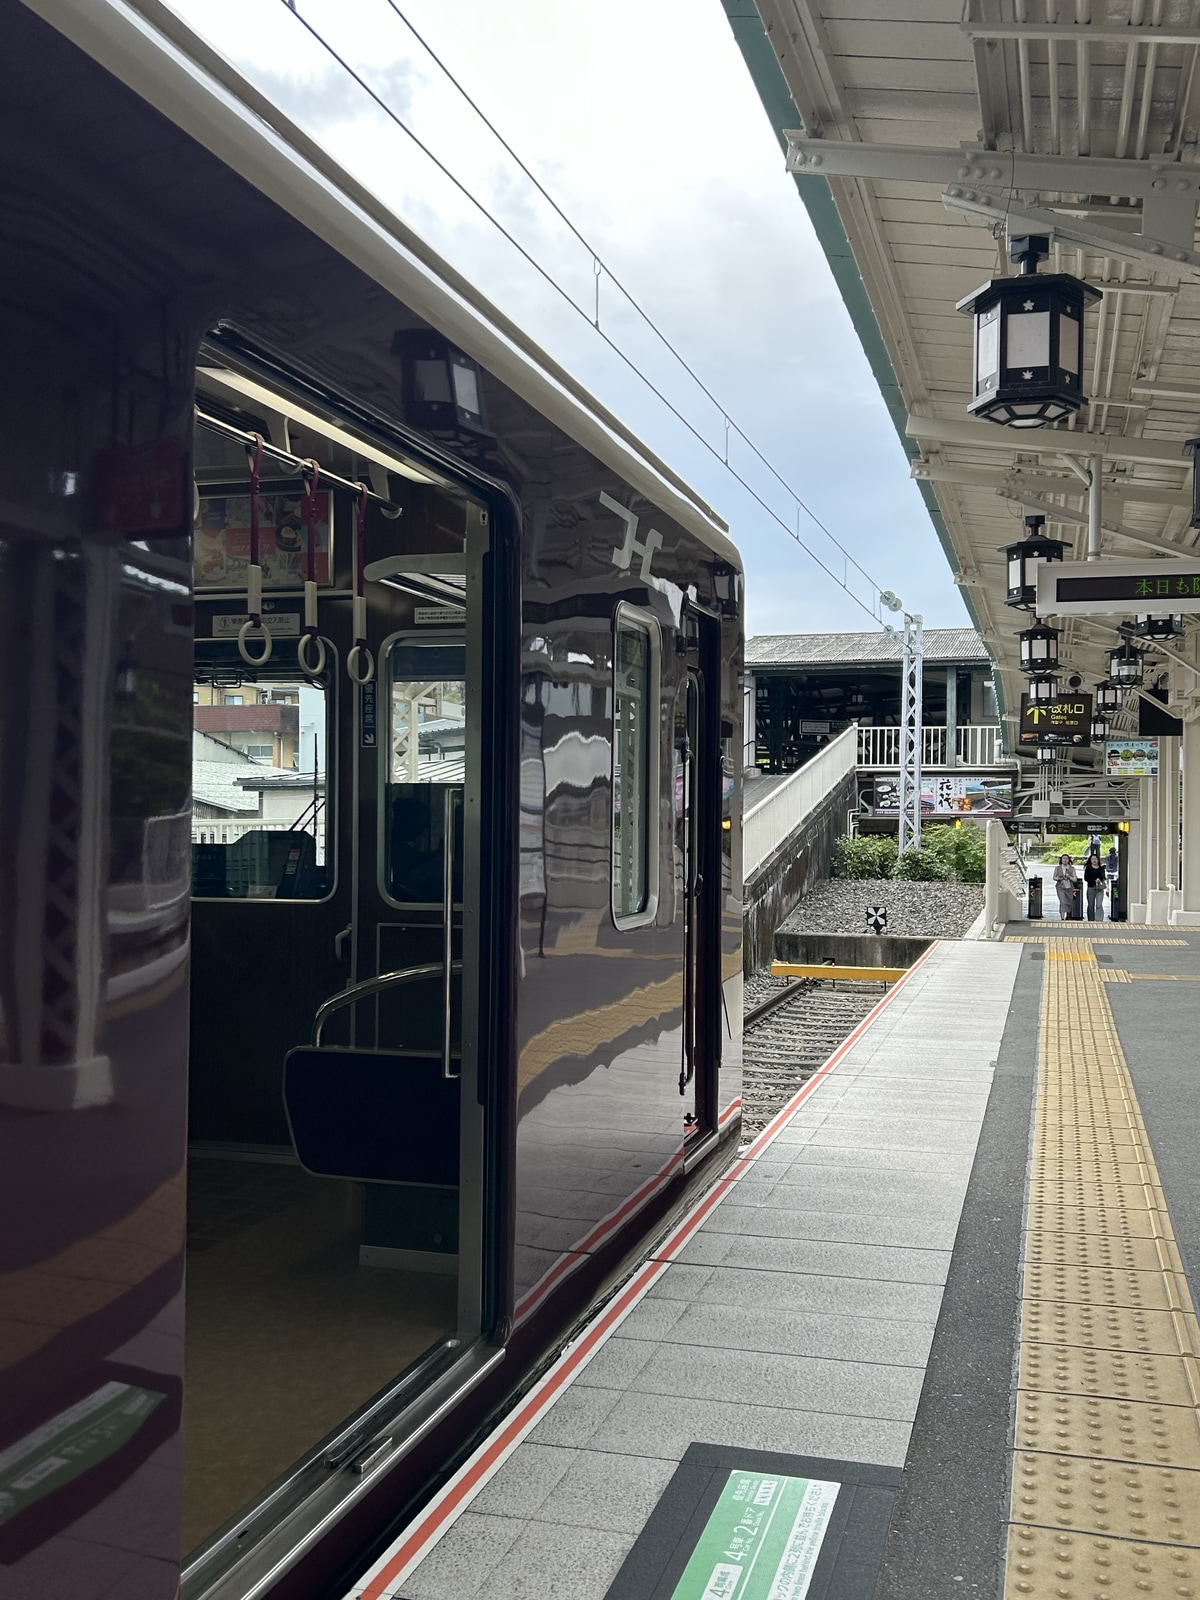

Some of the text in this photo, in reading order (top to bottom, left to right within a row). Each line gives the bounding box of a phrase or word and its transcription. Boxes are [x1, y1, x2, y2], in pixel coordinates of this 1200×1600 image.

[1051, 703, 1085, 714] 改札口
[807, 1531, 820, 1546] yellow
[804, 1545, 814, 1555] the
[798, 1554, 811, 1572] behind
[795, 1573, 805, 1585] lines
